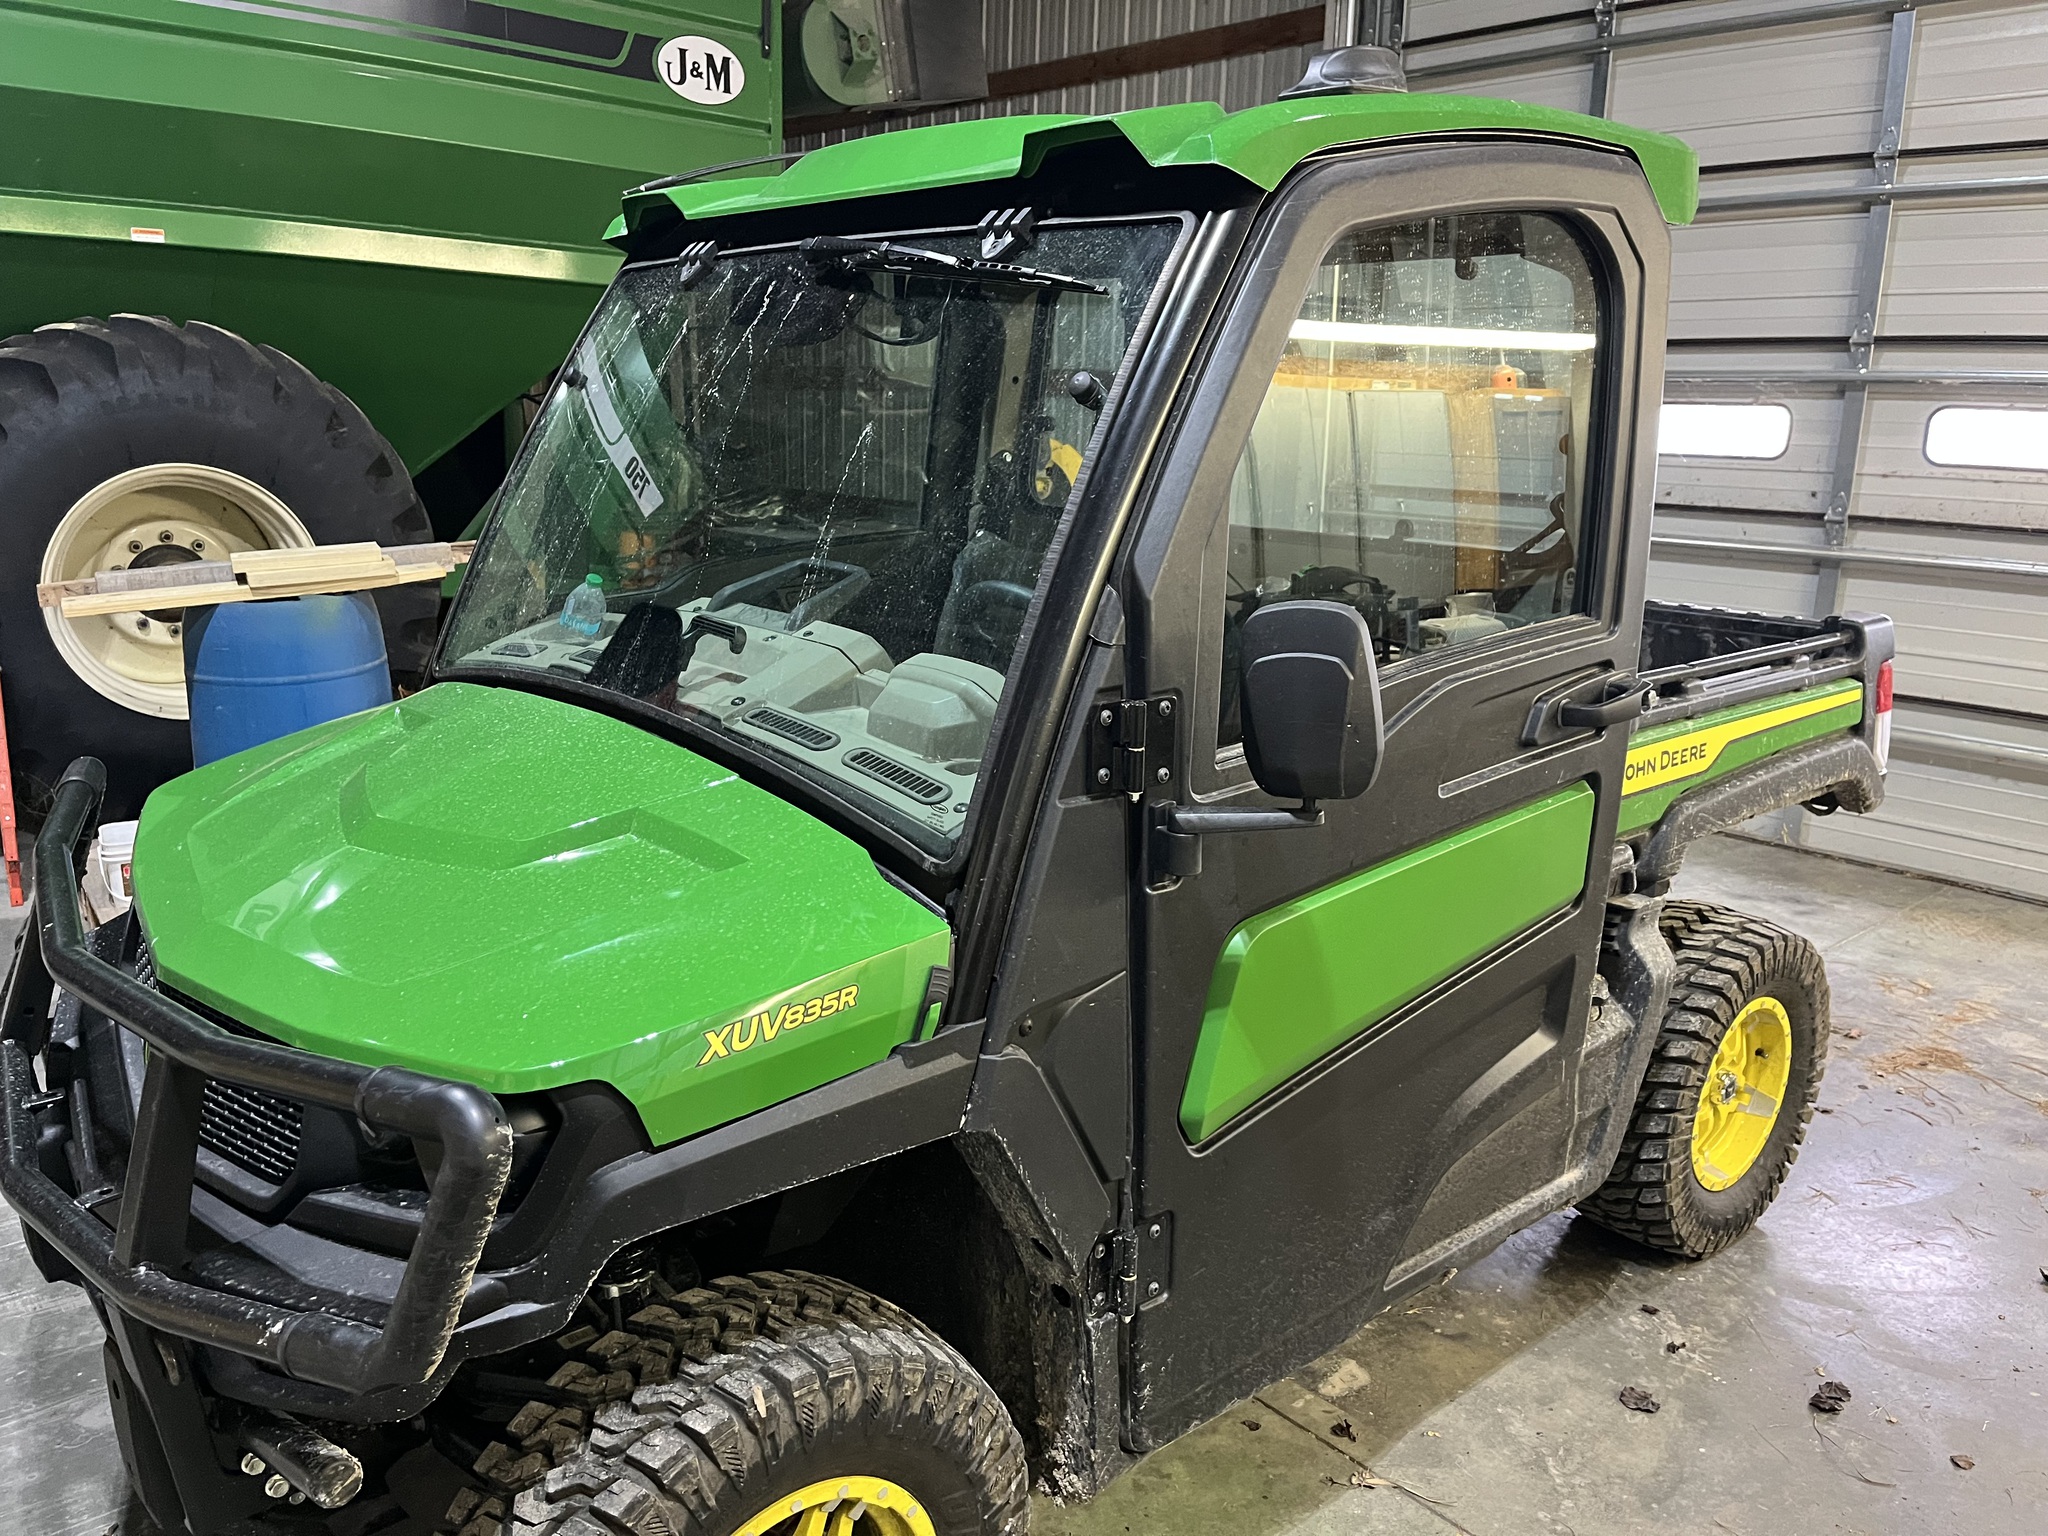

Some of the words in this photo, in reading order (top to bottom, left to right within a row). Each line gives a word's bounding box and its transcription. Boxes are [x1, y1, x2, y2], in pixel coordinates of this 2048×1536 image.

[665, 47, 732, 95] J&M
[1625, 757, 1657, 781] OHN
[1660, 742, 1707, 770] DEERE
[695, 984, 859, 1068] XUV835R
